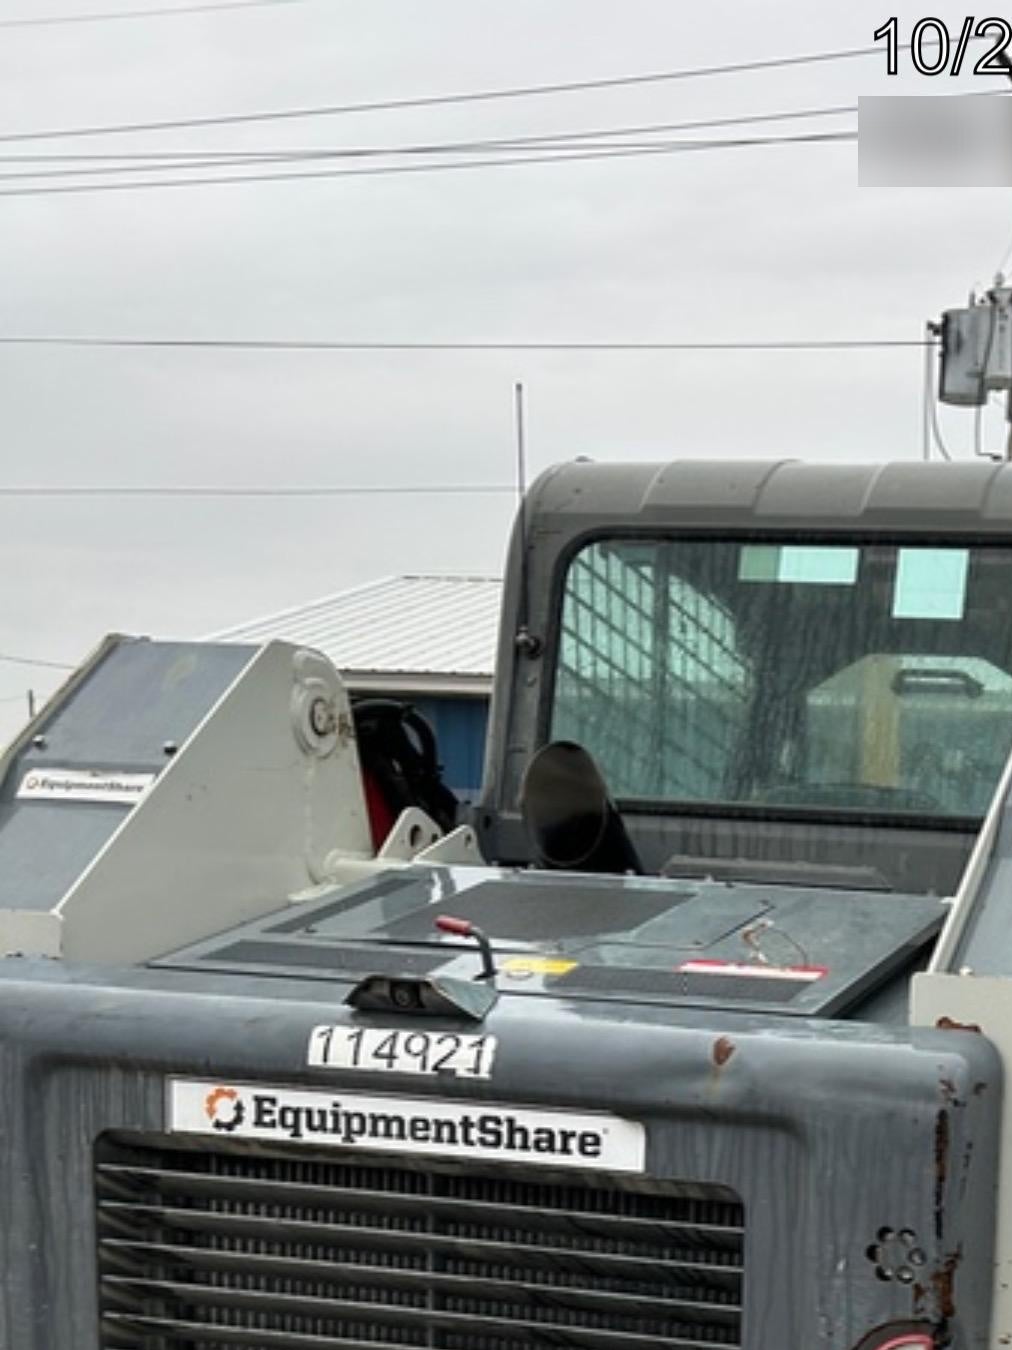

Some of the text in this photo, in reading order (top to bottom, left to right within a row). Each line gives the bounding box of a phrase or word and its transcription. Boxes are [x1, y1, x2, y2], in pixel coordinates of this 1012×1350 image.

[40, 776, 145, 793] EquipmentShare
[317, 1026, 488, 1075] 114921
[252, 1095, 603, 1158] EquipmentShare
